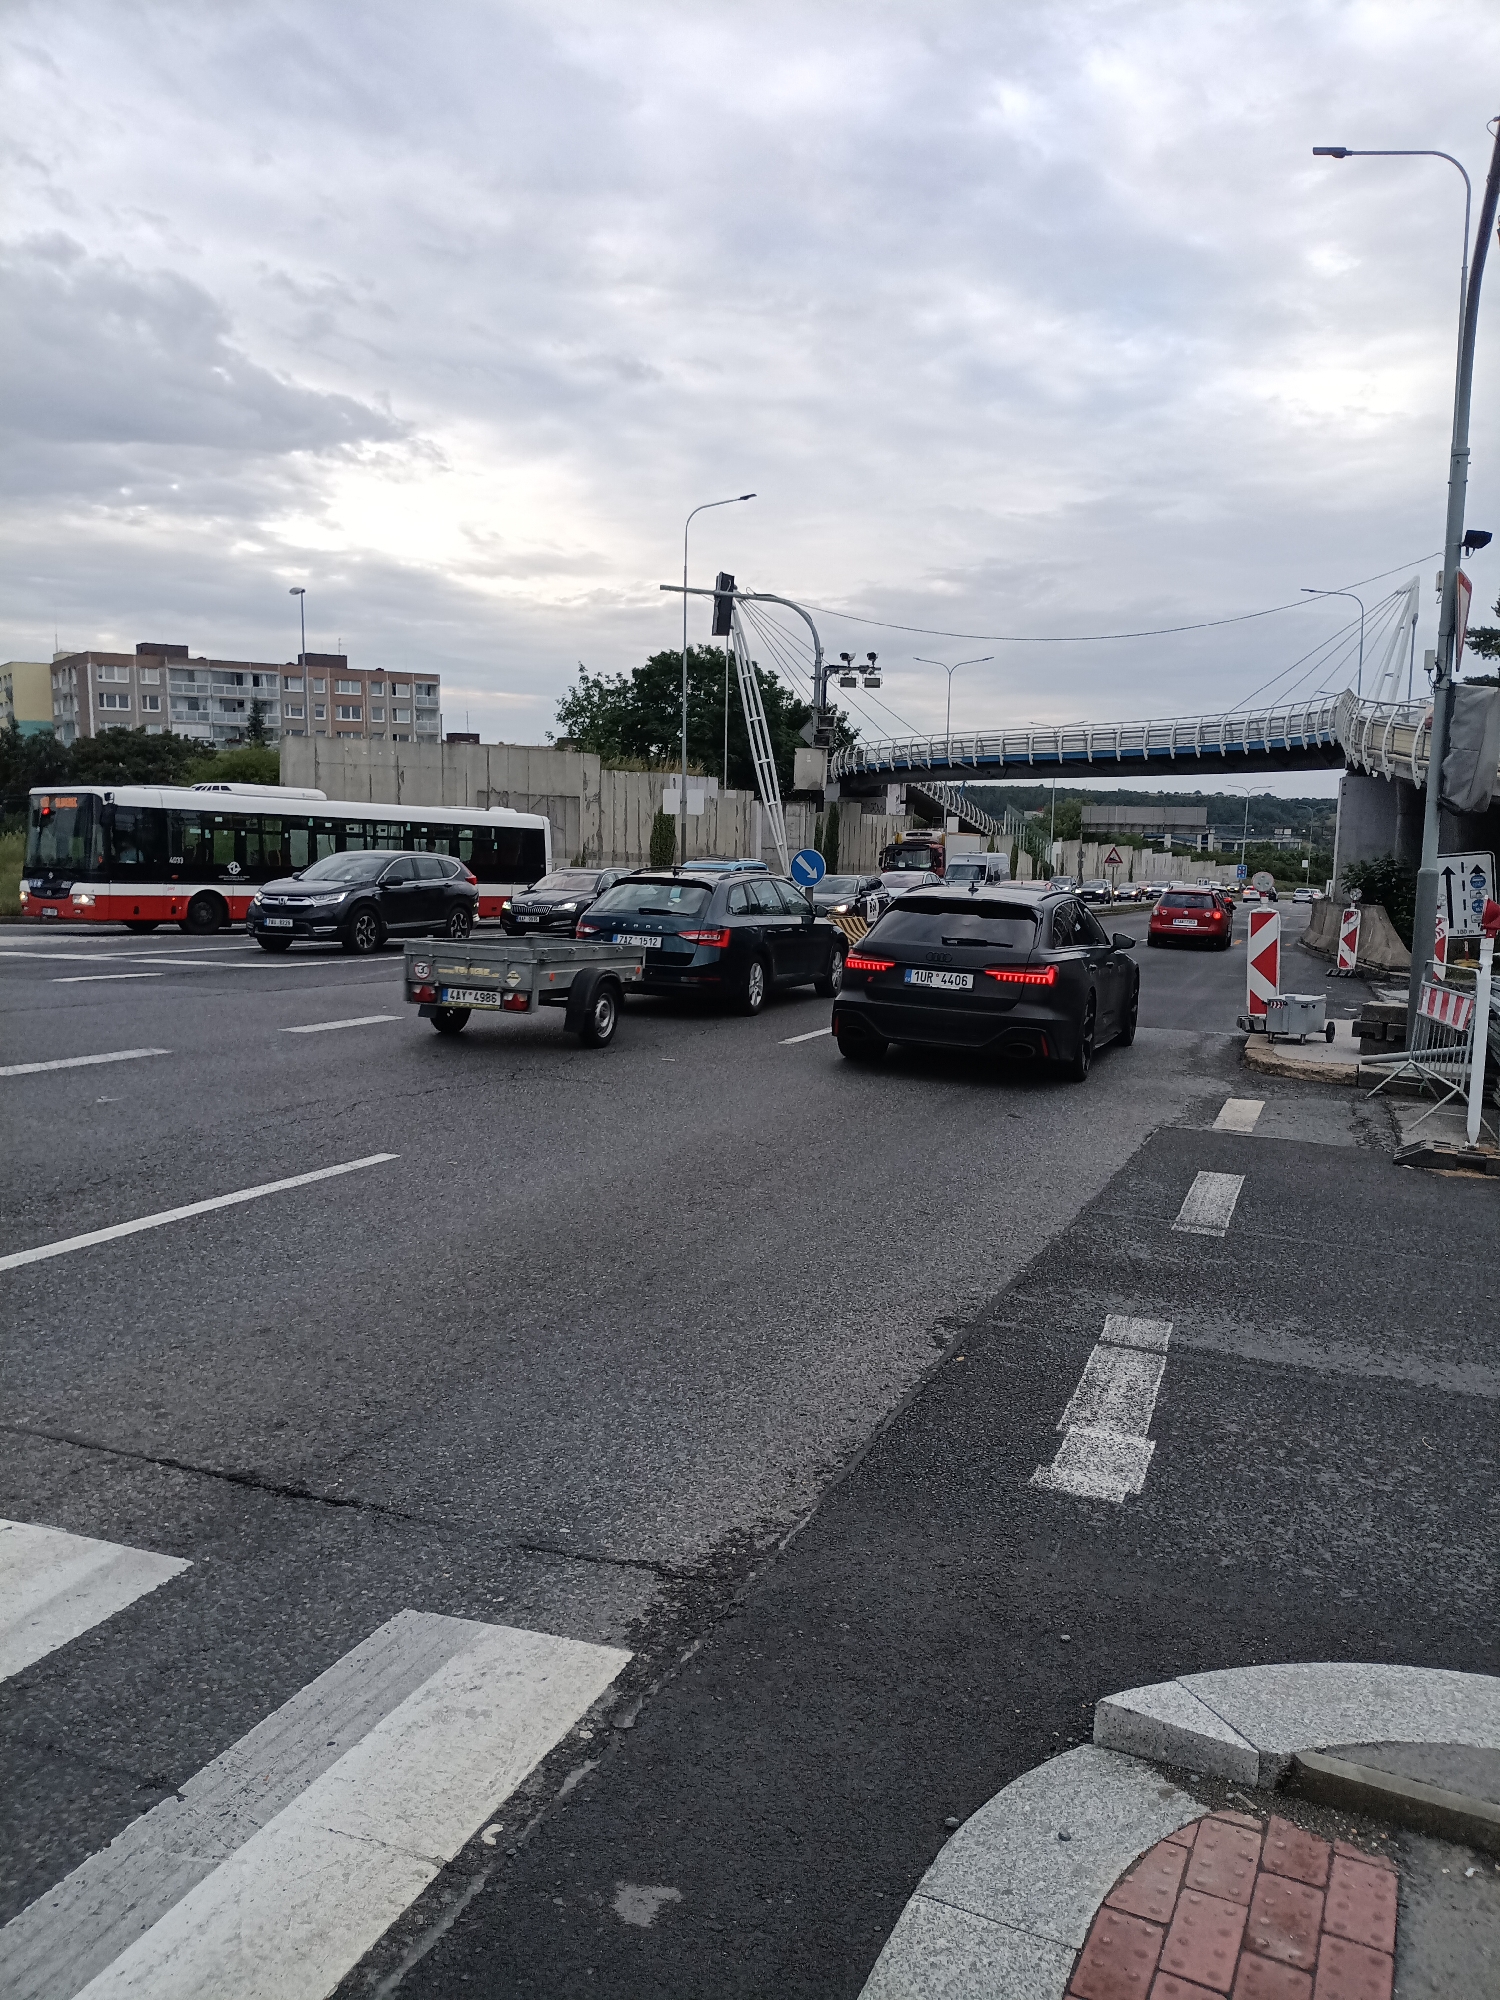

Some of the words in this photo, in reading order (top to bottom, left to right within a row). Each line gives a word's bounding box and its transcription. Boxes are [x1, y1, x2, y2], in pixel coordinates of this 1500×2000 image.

[618, 935, 634, 945] 7AZ
[639, 937, 658, 947] 1512
[914, 970, 933, 984] 1UR
[940, 973, 968, 987] 4406
[449, 989, 467, 1001] 4AY
[473, 991, 498, 1004] 4986
